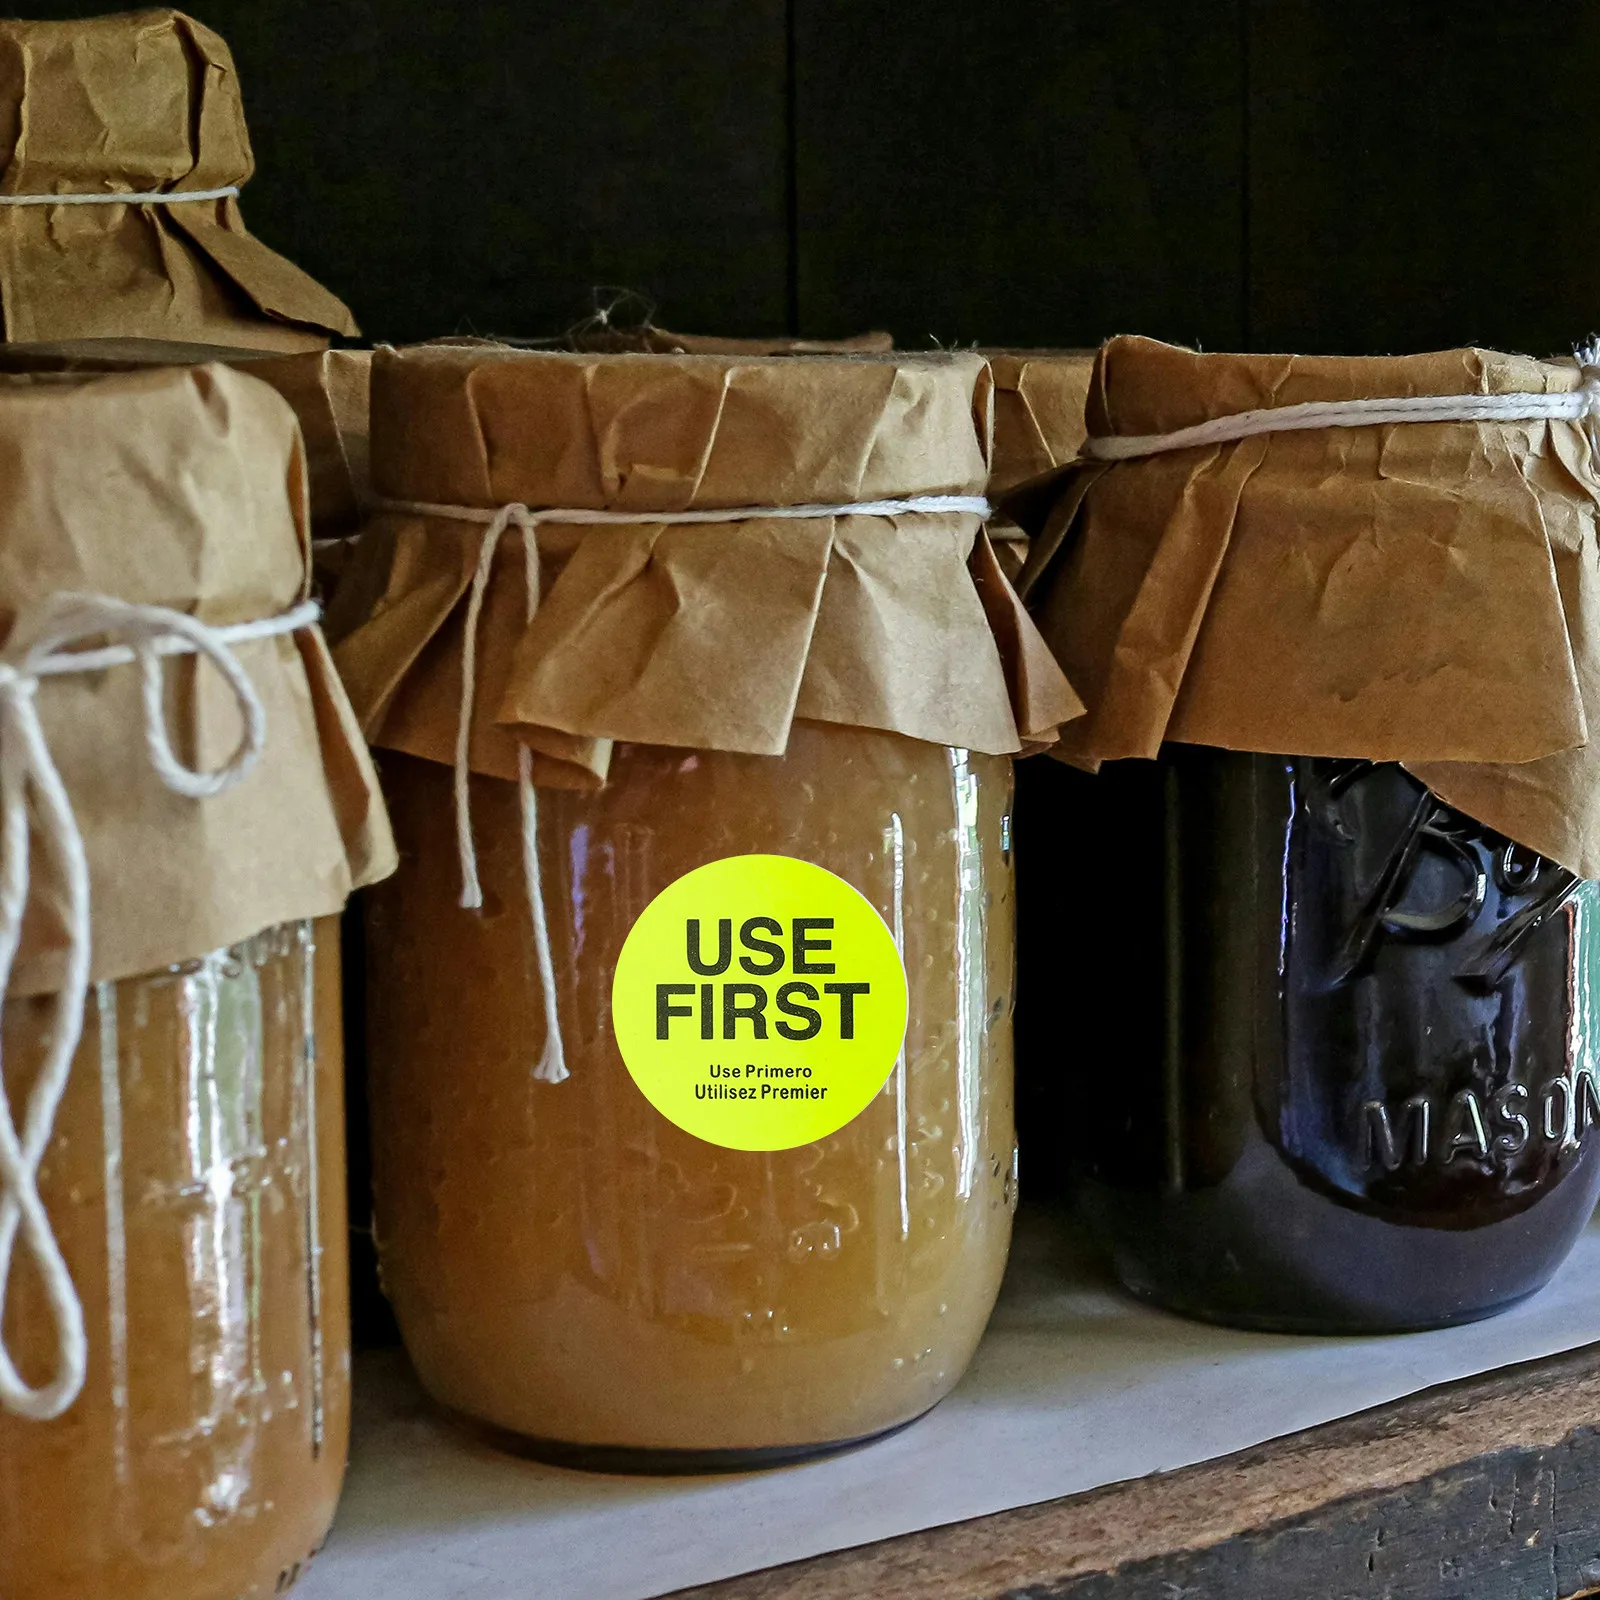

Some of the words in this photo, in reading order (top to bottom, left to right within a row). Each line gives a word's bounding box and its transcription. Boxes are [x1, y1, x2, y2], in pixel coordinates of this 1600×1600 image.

[686, 916, 836, 976] USE
[655, 981, 871, 1041] FIRST
[709, 1064, 741, 1078] Use
[745, 1064, 813, 1079] Primero
[695, 1083, 757, 1100] Utilisez
[761, 1083, 829, 1100] Premier
